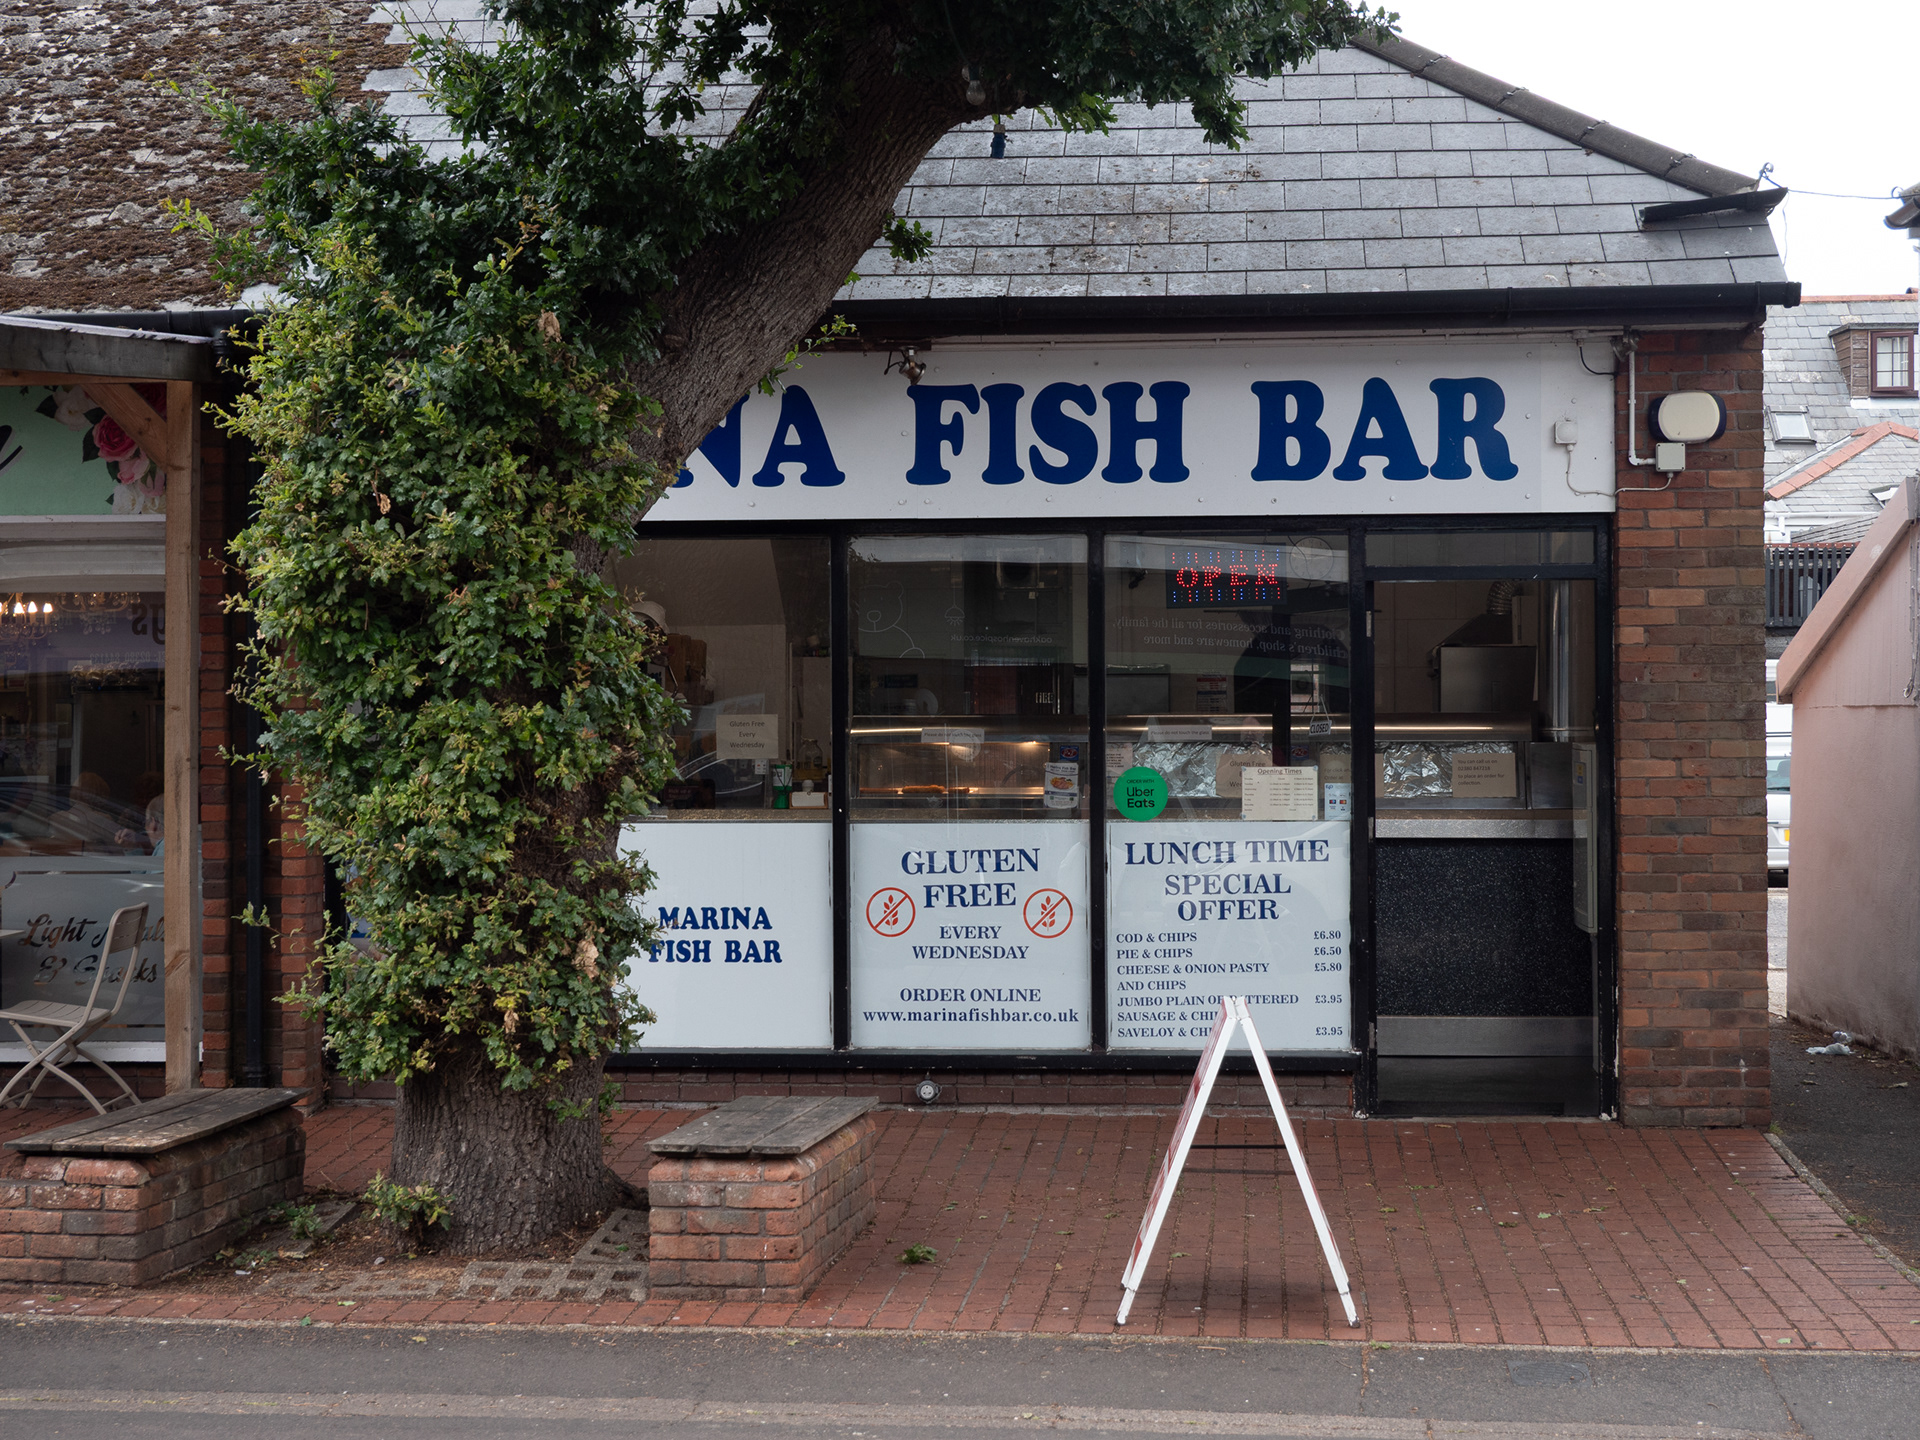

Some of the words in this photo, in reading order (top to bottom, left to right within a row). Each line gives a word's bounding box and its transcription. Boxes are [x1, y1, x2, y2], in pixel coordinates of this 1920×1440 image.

[906, 381, 1190, 485] FISH
[1250, 377, 1519, 481] BAR
[1176, 563, 1279, 588] OPEN
[1311, 723, 1329, 733] CLOSED
[1127, 787, 1154, 797] Uber
[1127, 798, 1155, 808] Eats
[1125, 841, 1235, 864] LUNCH
[1246, 840, 1329, 862] TIME
[900, 848, 1040, 875] GLUTEN
[1165, 874, 1291, 895] SPECIAL
[923, 883, 1016, 908] FREE
[1178, 899, 1279, 921] OFFER
[658, 907, 773, 930] MARINA
[17, 913, 98, 948] Light
[940, 926, 1001, 939] EVERY
[1116, 934, 1142, 943] COD
[1146, 934, 1154, 942] &
[1159, 933, 1197, 942] CHIPS
[1314, 931, 1341, 939] £6.80
[648, 940, 711, 963] FISH
[725, 940, 782, 963] BAR
[912, 946, 1029, 959] WEDNESDAY
[1117, 949, 1140, 959] PIE
[1142, 949, 1150, 958] &
[1154, 948, 1192, 958] CHIPS
[1314, 947, 1341, 955] £6.50
[34, 955, 67, 985] &
[1117, 965, 1169, 975] CHEESE
[1173, 965, 1181, 973] &
[1185, 964, 1225, 973] ONION
[1230, 963, 1269, 972] PASTY
[1315, 963, 1342, 971] £5.80
[1117, 982, 1144, 990] AND
[1148, 981, 1186, 990] CHIPS
[900, 988, 966, 1001] ORDER
[970, 989, 1040, 1001] ONLINE
[1118, 997, 1162, 1006] JUMBO
[1167, 996, 1204, 1005] PLAIN
[1315, 995, 1342, 1003] £3.95
[863, 1008, 1078, 1021] www.marinafishbar.co.uk
[1118, 1012, 1175, 1021] SAUSAGE
[1179, 1012, 1187, 1020] &
[1191, 1011, 1218, 1021] CHI
[1118, 1028, 1176, 1038] SAVELOY
[1178, 1028, 1186, 1037] &
[1316, 1027, 1342, 1035] £3.95
